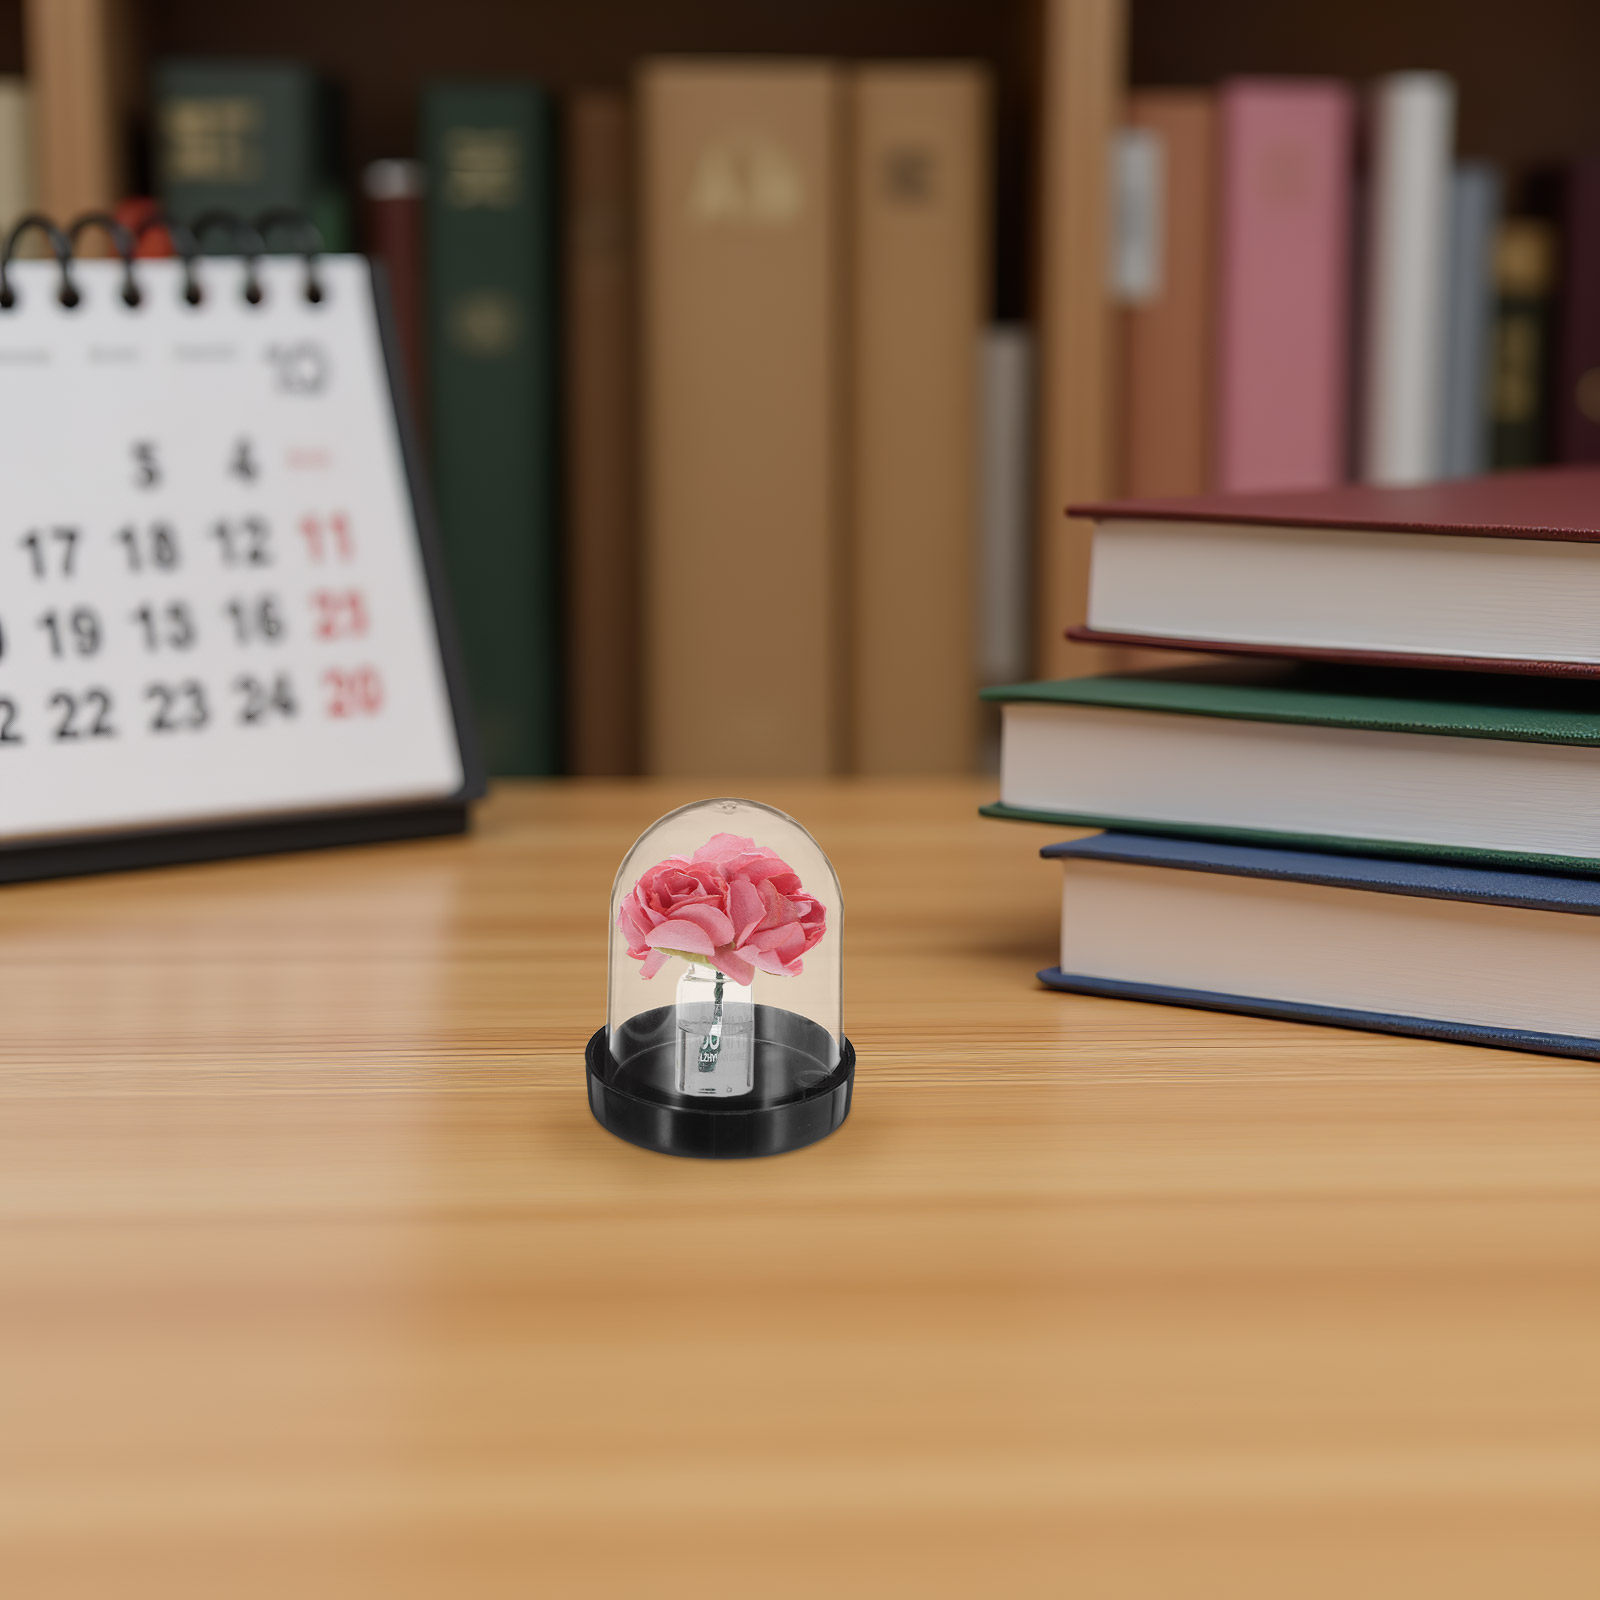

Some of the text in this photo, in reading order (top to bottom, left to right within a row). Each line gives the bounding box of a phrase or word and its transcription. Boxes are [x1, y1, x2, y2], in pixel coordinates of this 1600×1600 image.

[18, 525, 82, 579] 17
[209, 514, 274, 570] 12
[299, 511, 354, 563] 11
[36, 605, 105, 660] 19
[46, 685, 119, 745] 22
[143, 678, 213, 736] 23
[231, 671, 301, 728] 24
